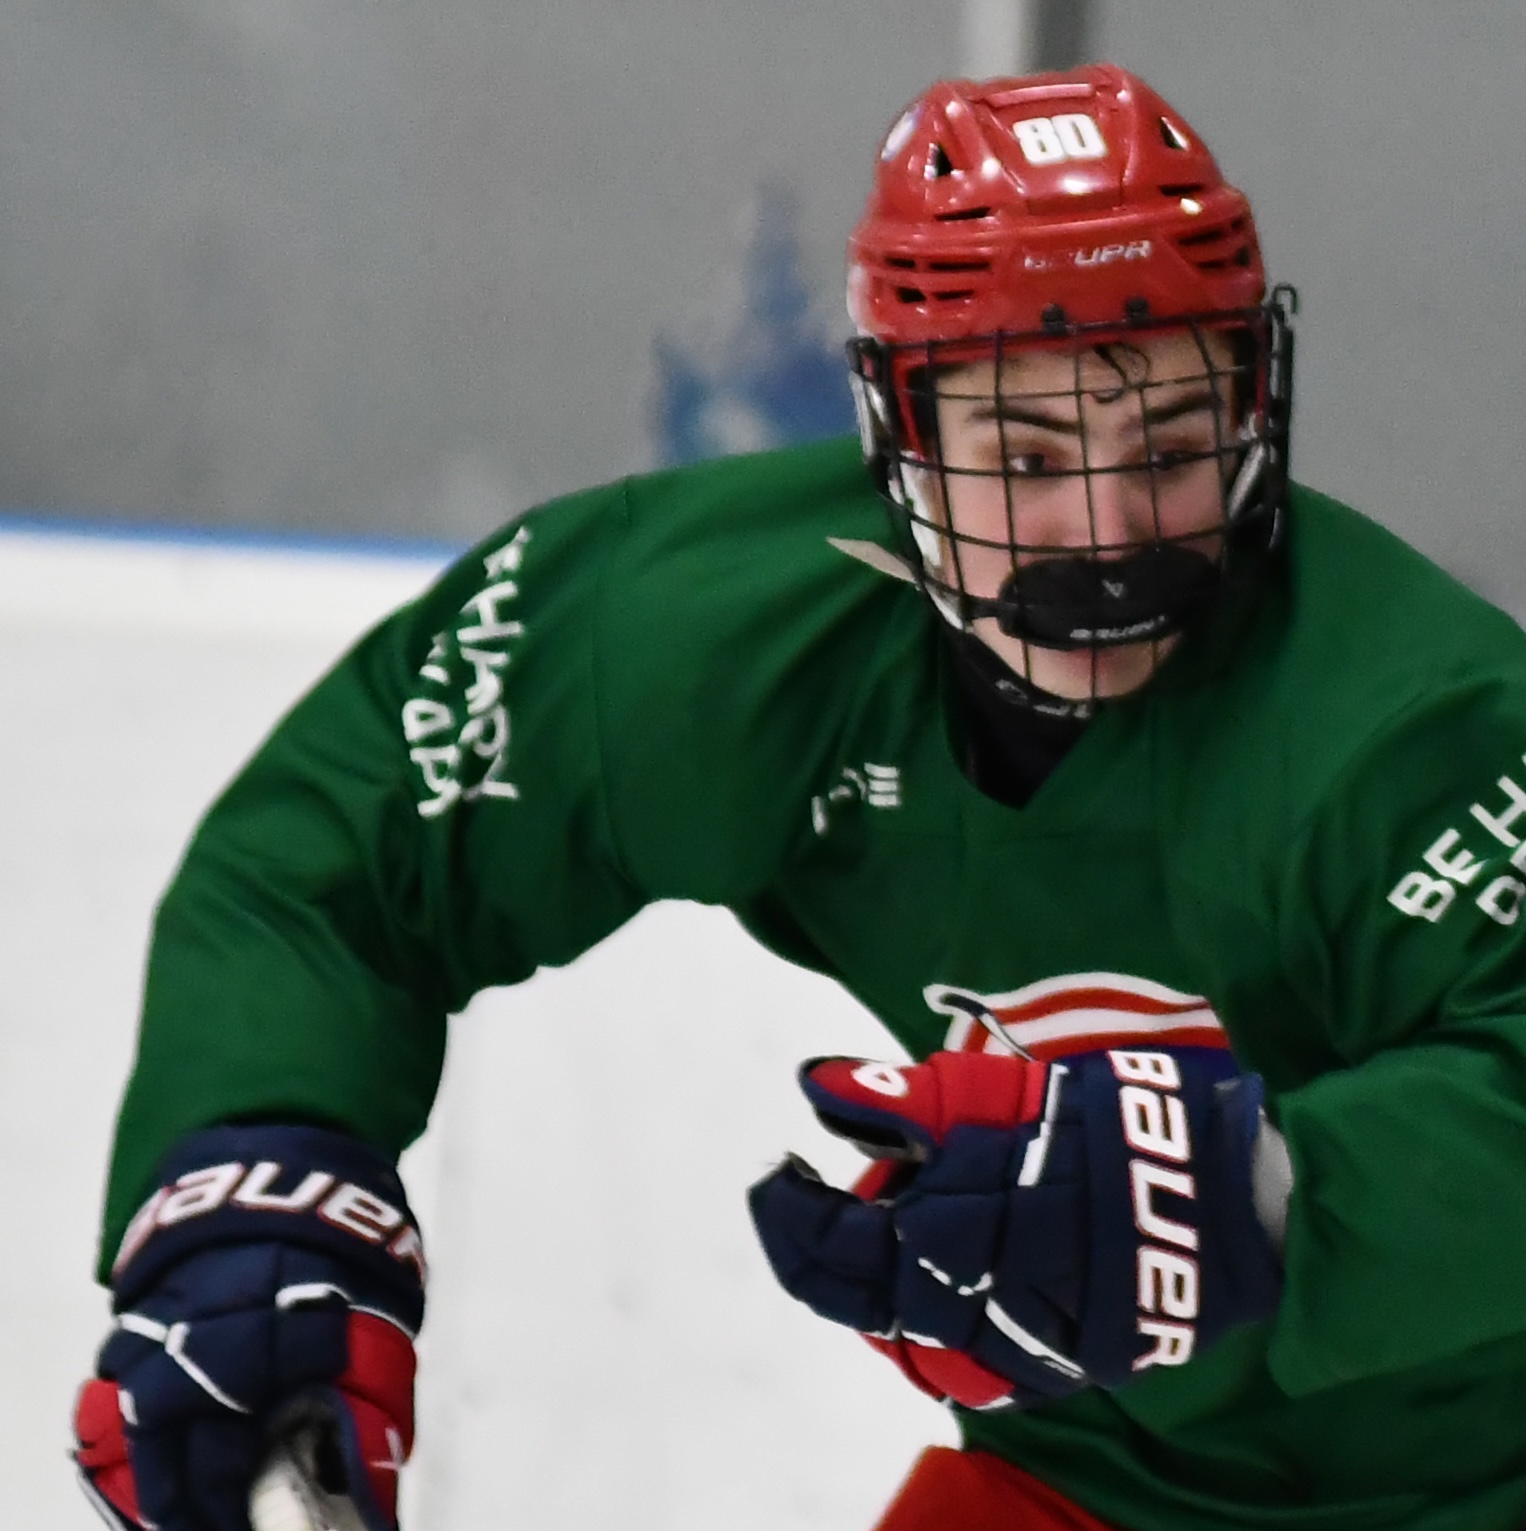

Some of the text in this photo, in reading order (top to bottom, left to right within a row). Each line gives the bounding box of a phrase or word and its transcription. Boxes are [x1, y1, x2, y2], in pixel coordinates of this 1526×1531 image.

[1012, 112, 1108, 167] 80
[1386, 826, 1487, 924] BE
[1107, 1049, 1200, 1372] BAUER
